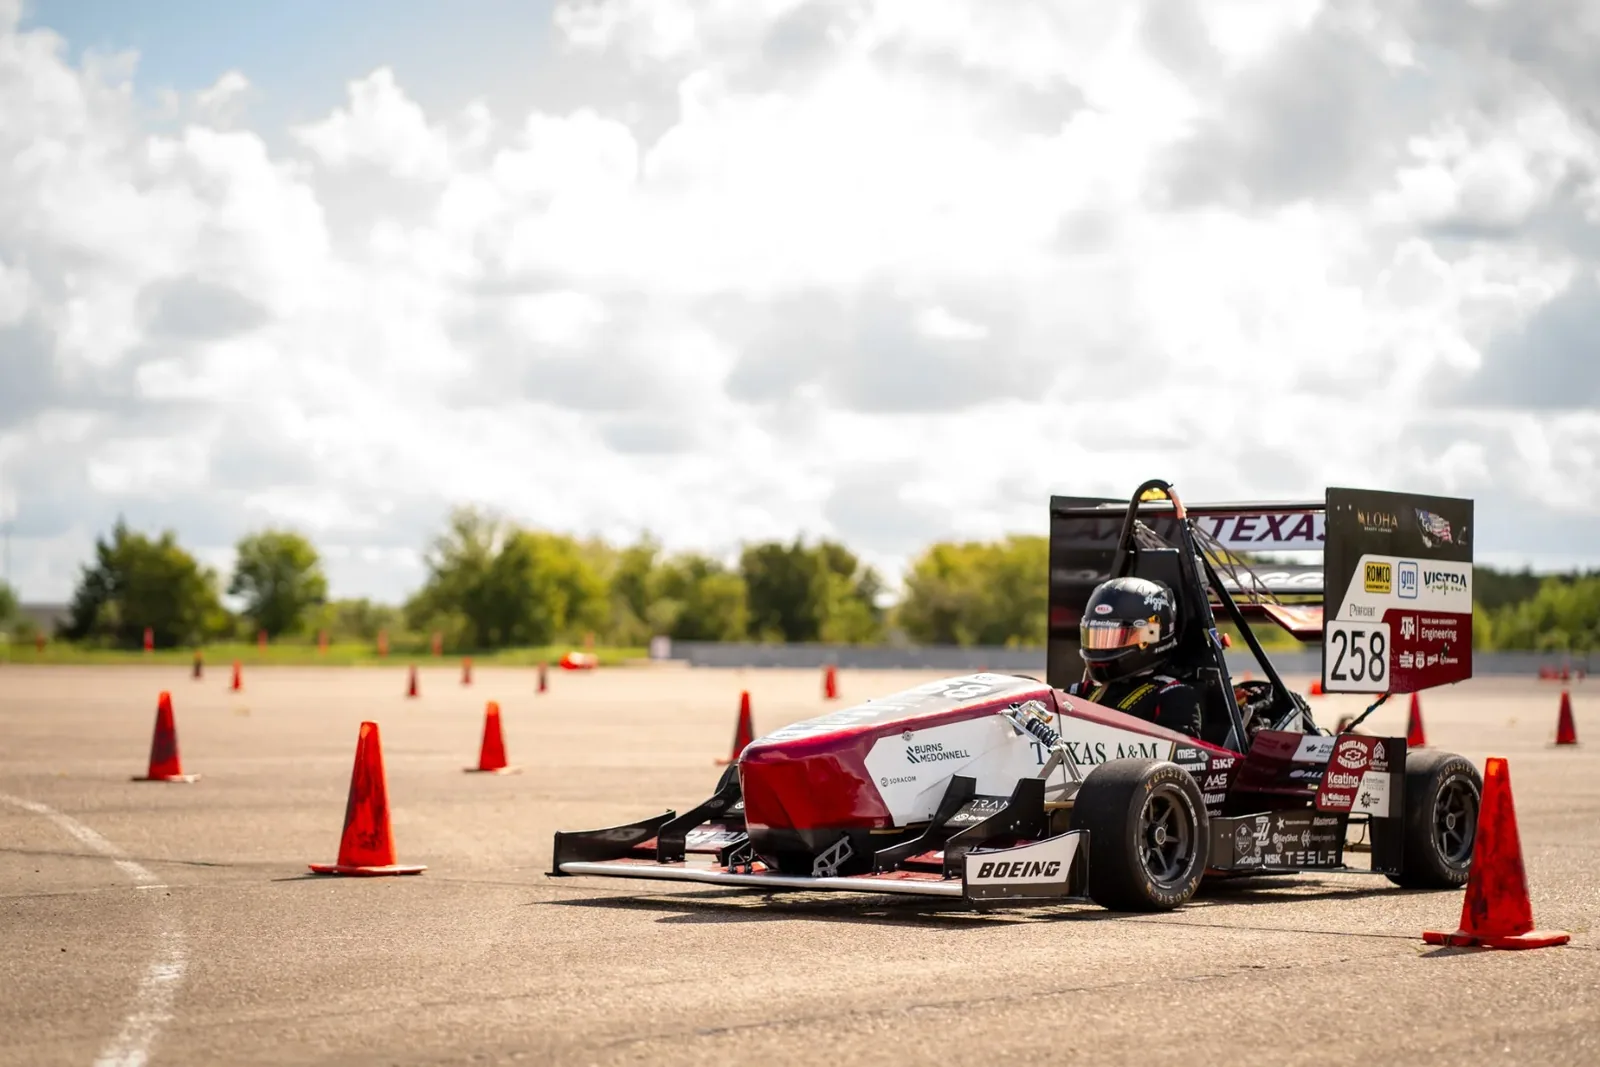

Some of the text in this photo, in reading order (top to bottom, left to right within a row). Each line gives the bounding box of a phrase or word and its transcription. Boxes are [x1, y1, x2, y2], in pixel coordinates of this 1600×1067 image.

[1366, 564, 1390, 583] ROMCO
[1401, 570, 1414, 588] gm
[1421, 627, 1457, 642] Engineering
[1331, 629, 1385, 682] 258
[914, 743, 943, 753] BURNS
[1030, 742, 1107, 765] TXAS
[1116, 742, 1158, 759] A&M
[1212, 758, 1235, 769] SKF
[889, 776, 916, 785] SORACOM
[1328, 772, 1359, 788] Keating
[1264, 854, 1281, 864] NSK
[1285, 851, 1336, 864] TESLA
[977, 861, 1061, 878] BOEING
